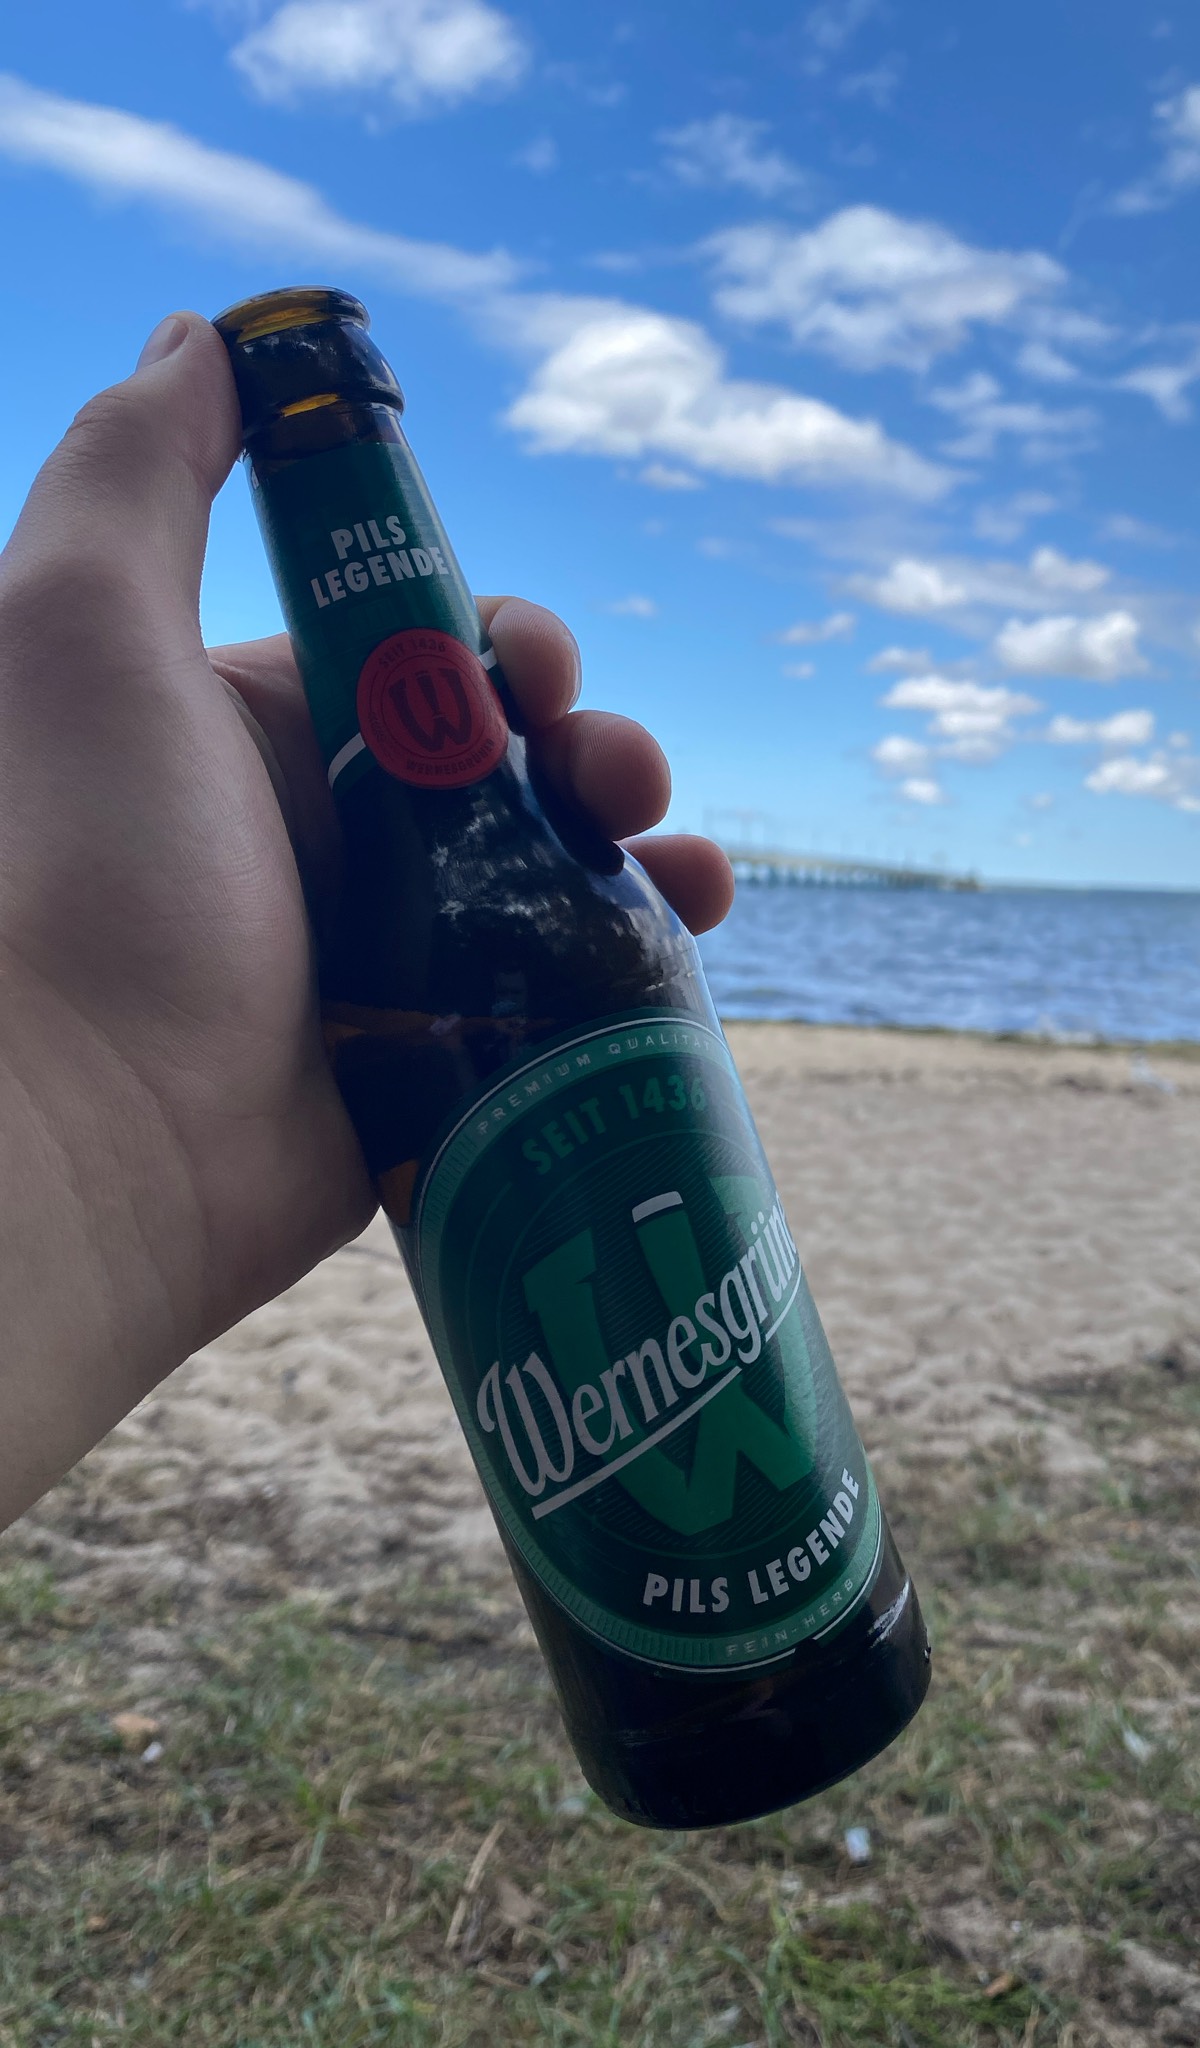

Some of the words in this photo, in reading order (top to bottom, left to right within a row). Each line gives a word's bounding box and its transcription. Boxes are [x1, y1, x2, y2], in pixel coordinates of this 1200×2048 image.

[310, 546, 449, 609] LEGENDE
[331, 515, 406, 560] PILS
[478, 1053, 590, 1135] PREMIUM
[521, 1097, 606, 1175] SEIT
[618, 1074, 707, 1120] 1436
[477, 1191, 797, 1496] Wernesgrün
[642, 1572, 730, 1613] PILS
[747, 1467, 859, 1605] LEGENDE
